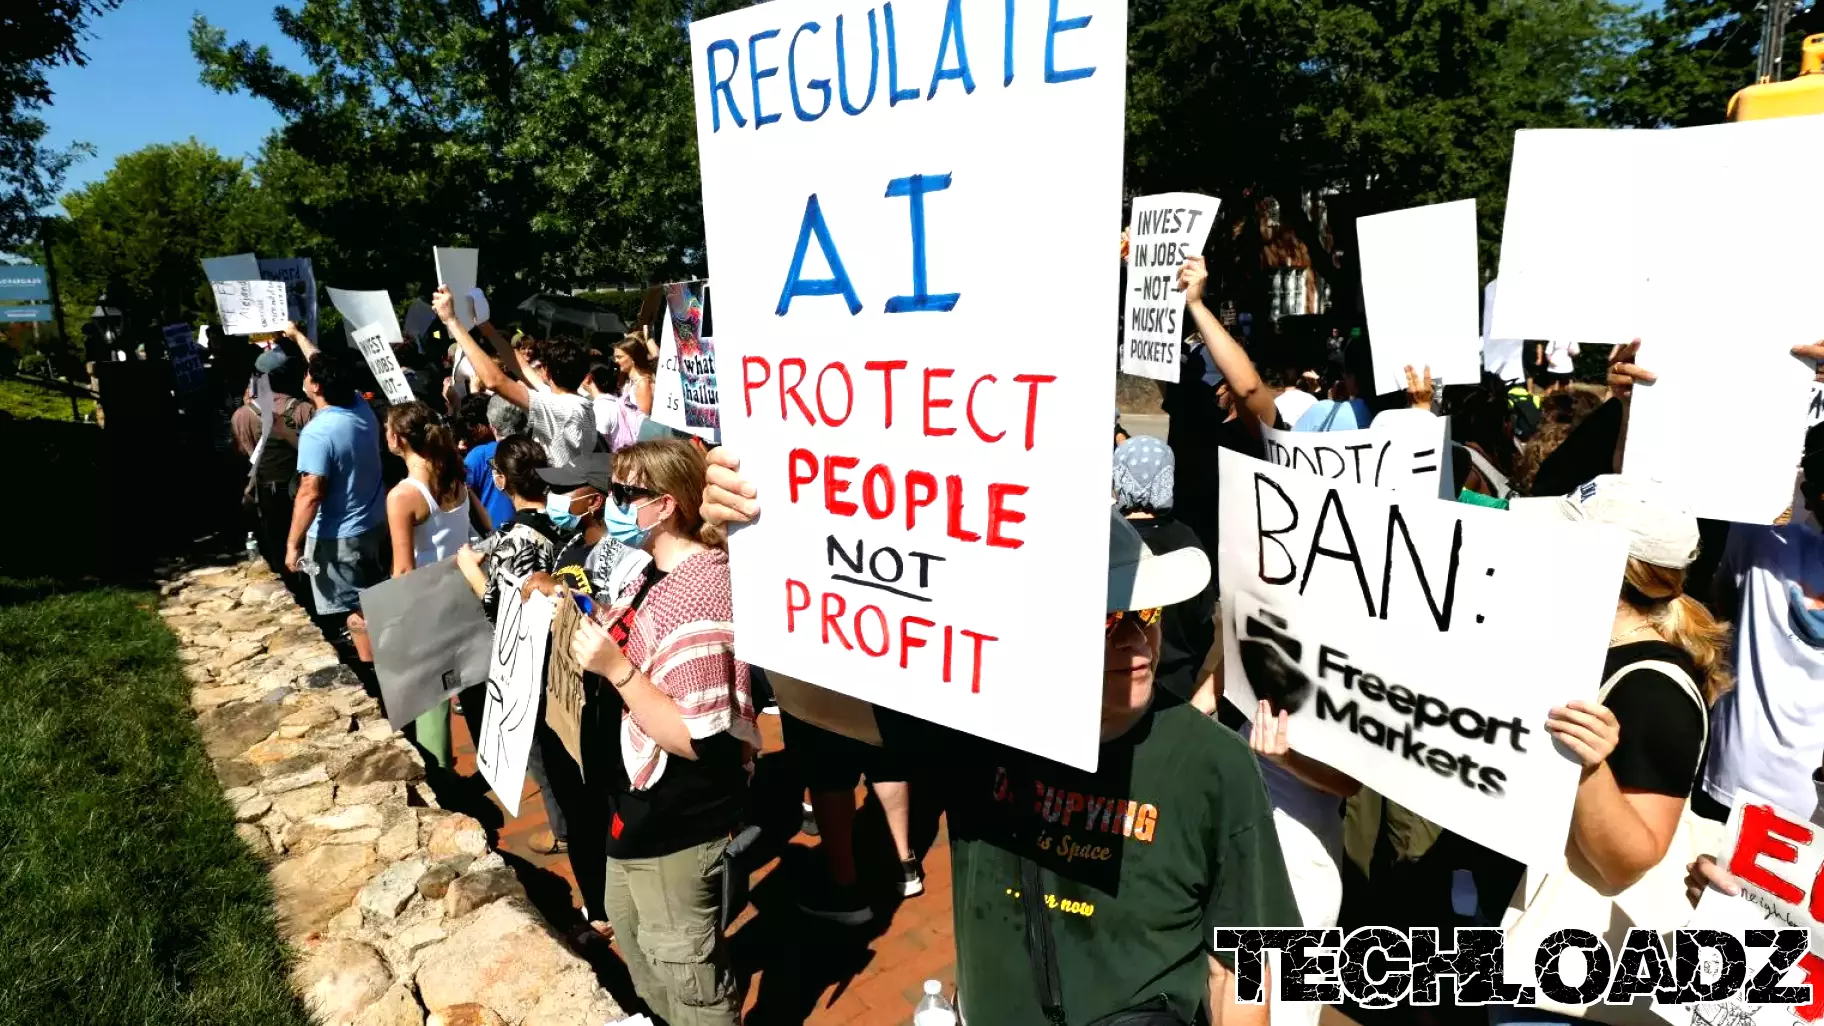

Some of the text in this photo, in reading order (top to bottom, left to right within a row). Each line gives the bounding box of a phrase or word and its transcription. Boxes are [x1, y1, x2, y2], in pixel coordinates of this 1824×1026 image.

[1137, 207, 1203, 236] INVEST
[775, 171, 961, 317] AI
[1135, 242, 1190, 267] IN JOBS
[1132, 307, 1177, 334] MUSK'S
[684, 355, 716, 375] what
[1130, 339, 1175, 364] POCKETS
[666, 393, 679, 411] is
[742, 354, 1058, 451] PROTECT
[789, 447, 1029, 549] PEOPLE
[827, 534, 946, 588] NOT
[1254, 472, 1495, 632] BAN:
[786, 578, 999, 693] PROFIT
[1318, 645, 1530, 753] Freeport
[1315, 686, 1507, 798] Markets
[1056, 834, 1112, 863] Space
[1061, 898, 1095, 917] now
